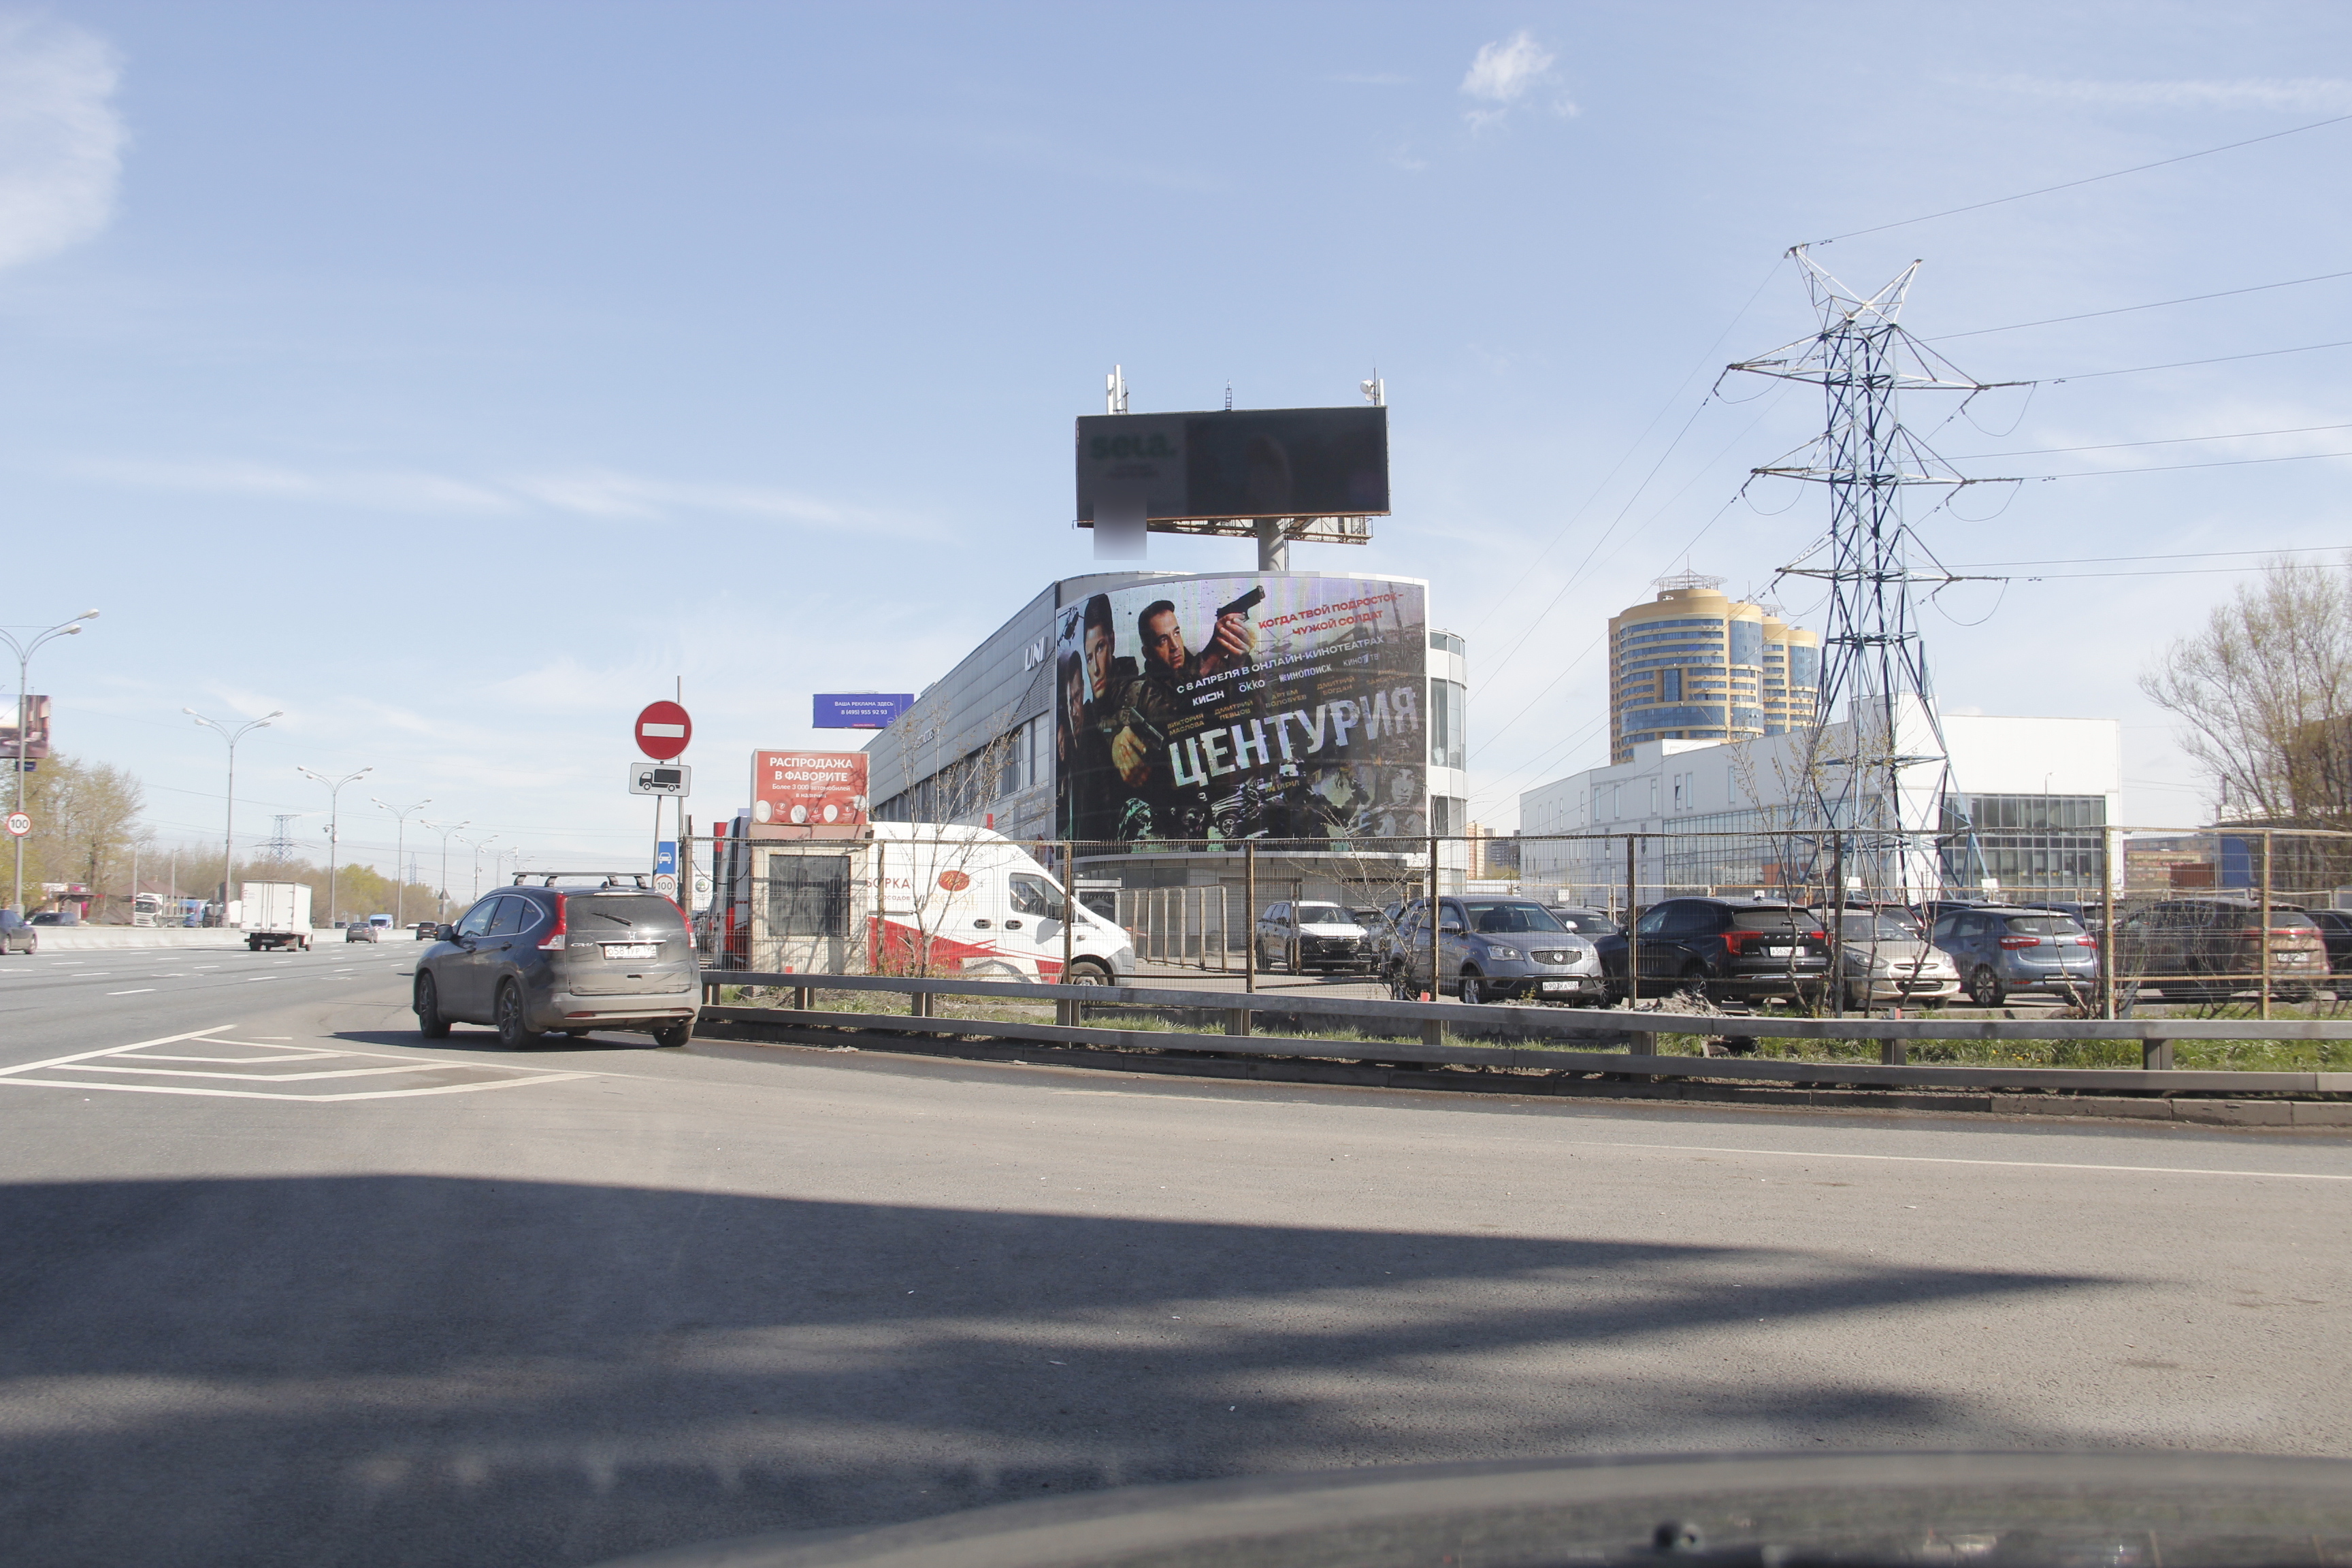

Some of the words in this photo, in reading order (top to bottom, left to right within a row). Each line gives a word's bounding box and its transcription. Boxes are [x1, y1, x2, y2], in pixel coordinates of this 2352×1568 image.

[1258, 614, 1298, 630] КОГДА
[1298, 605, 1331, 619] ТВОЙ
[1332, 593, 1398, 610] ПОДРОСТОК
[1292, 617, 1337, 636] ЧУЖОЙ
[1338, 610, 1384, 625] СОЛДАТ
[1177, 685, 1185, 693] С
[1186, 681, 1194, 691] 8
[1195, 669, 1241, 689] АПРЕЛЯ
[1241, 666, 1250, 675] В
[1251, 636, 1385, 672] ОНЛАЙН-КИНОТЕАТРАХ
[1279, 664, 1333, 683] КИНОПОИСК
[1167, 713, 1204, 730] ВИКТОРИЯ
[1169, 720, 1205, 736] МАСЛОВА
[1169, 687, 1419, 787] ЦЕНТУРИЯ
[770, 757, 854, 770] РАСПРОДАЖА
[774, 770, 783, 781] В
[785, 771, 848, 782] ФАВОРИТЕ
[10, 819, 29, 829] 100
[657, 881, 673, 890] 100
[866, 878, 911, 889] БОРКА
